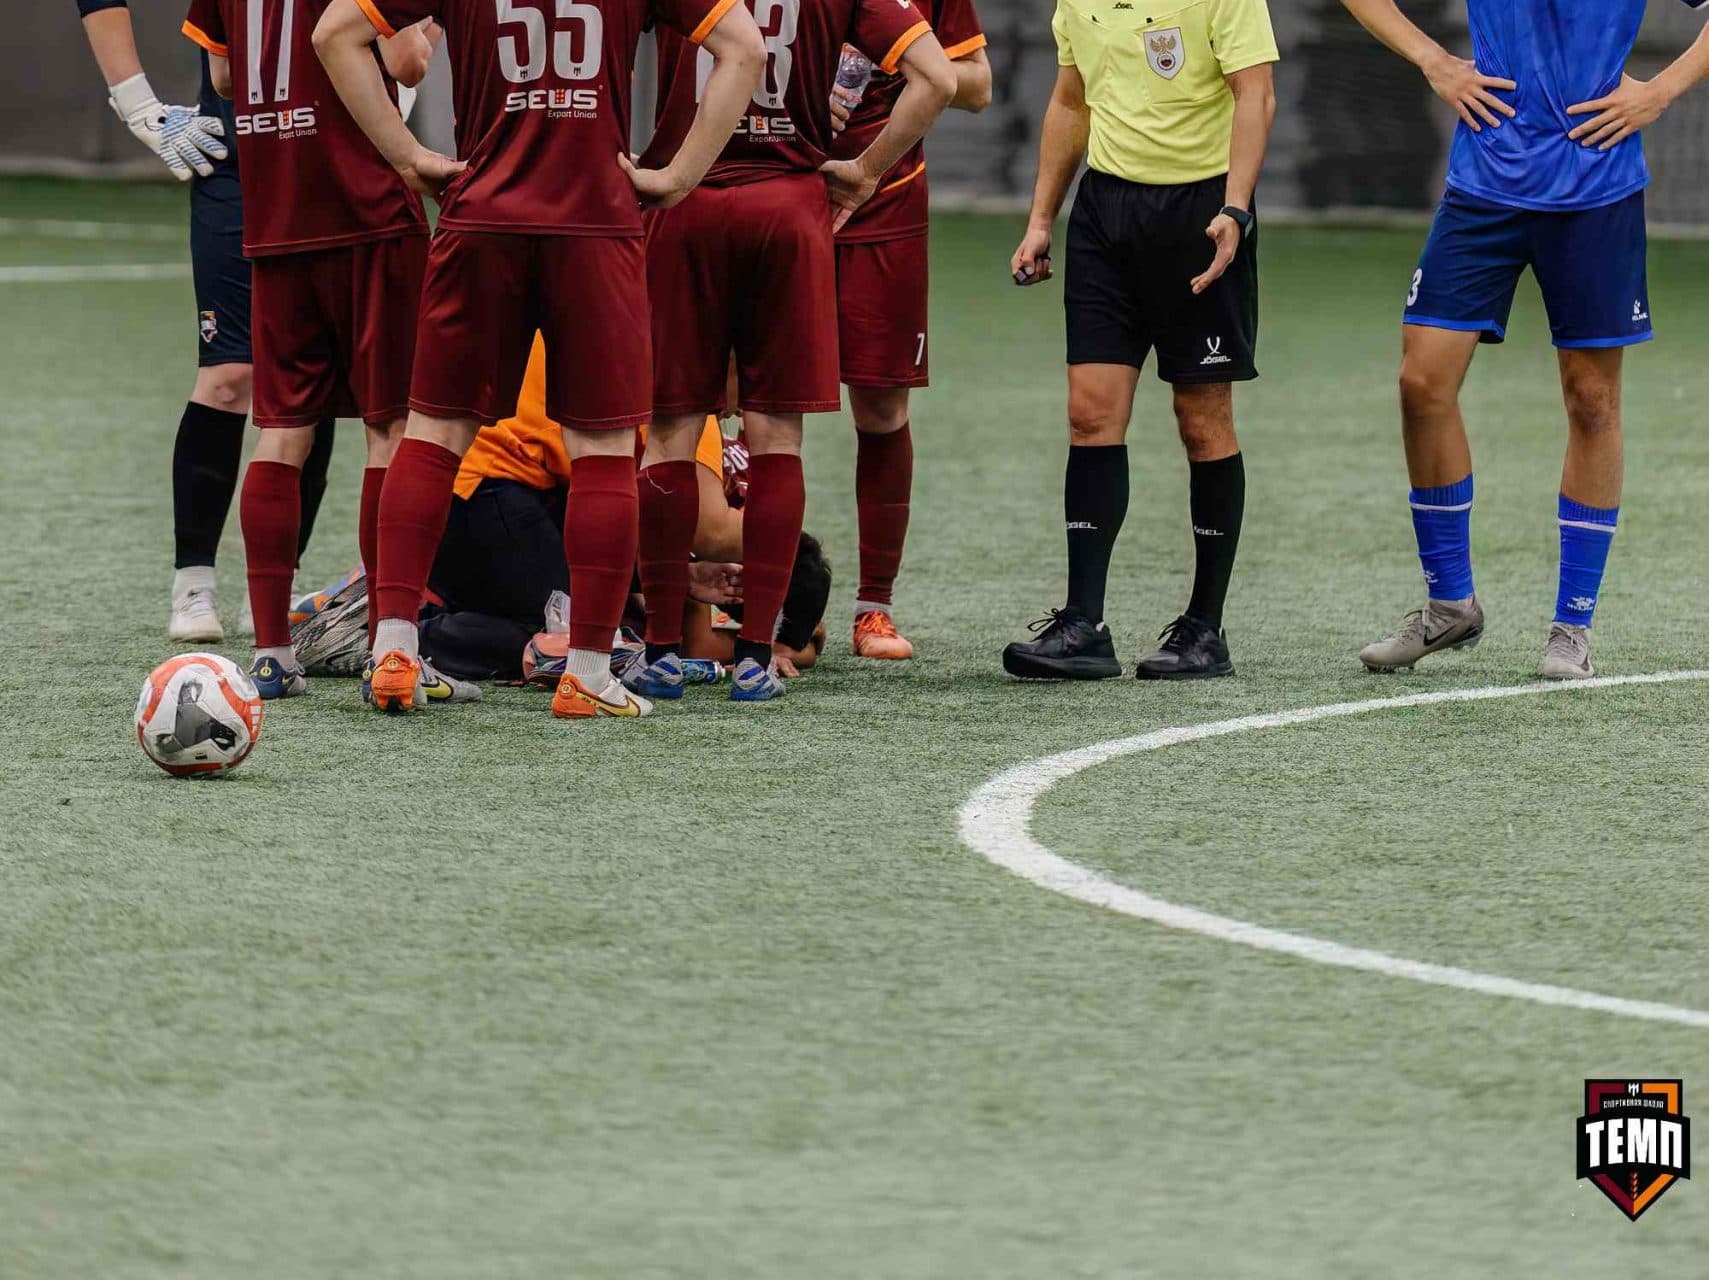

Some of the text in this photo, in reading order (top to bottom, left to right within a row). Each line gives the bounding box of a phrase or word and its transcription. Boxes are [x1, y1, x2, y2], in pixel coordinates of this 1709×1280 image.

[504, 89, 598, 112] SEUS
[235, 107, 316, 135] SEUS
[573, 110, 598, 119] Union
